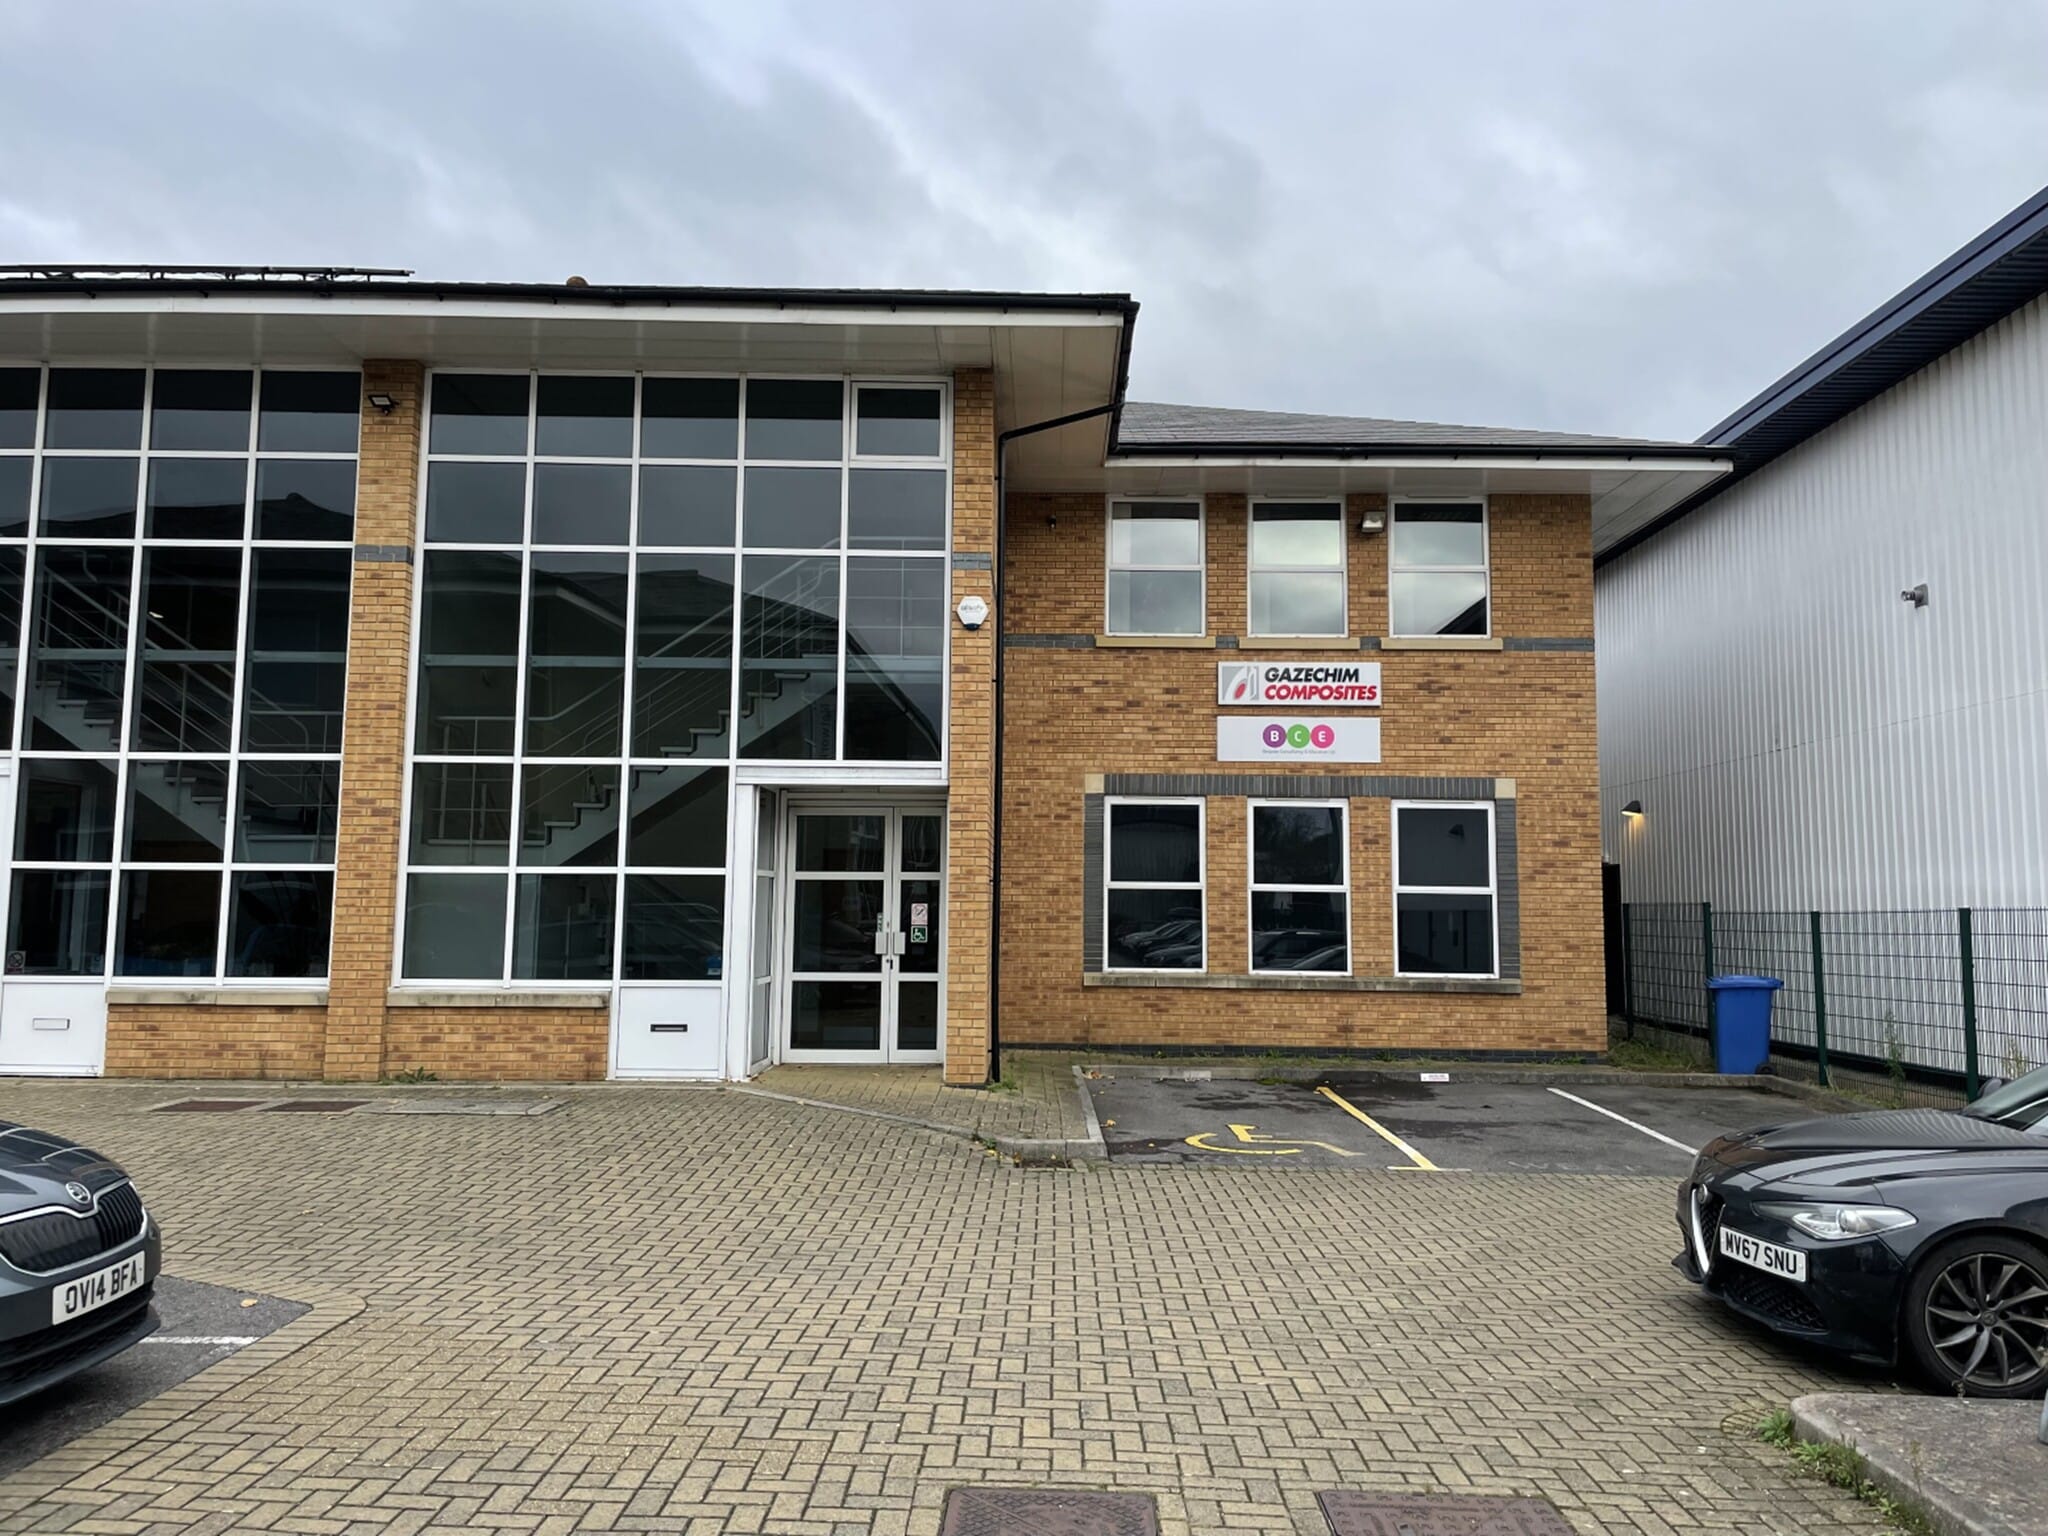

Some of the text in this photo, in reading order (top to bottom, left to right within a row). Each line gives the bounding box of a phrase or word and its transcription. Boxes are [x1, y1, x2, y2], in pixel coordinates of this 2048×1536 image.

[1264, 667, 1360, 683] GAZECHIM
[1264, 684, 1378, 700] COMPOSITES
[1763, 1246, 1798, 1275] SNU
[66, 1260, 138, 1314] OV14 BFA
